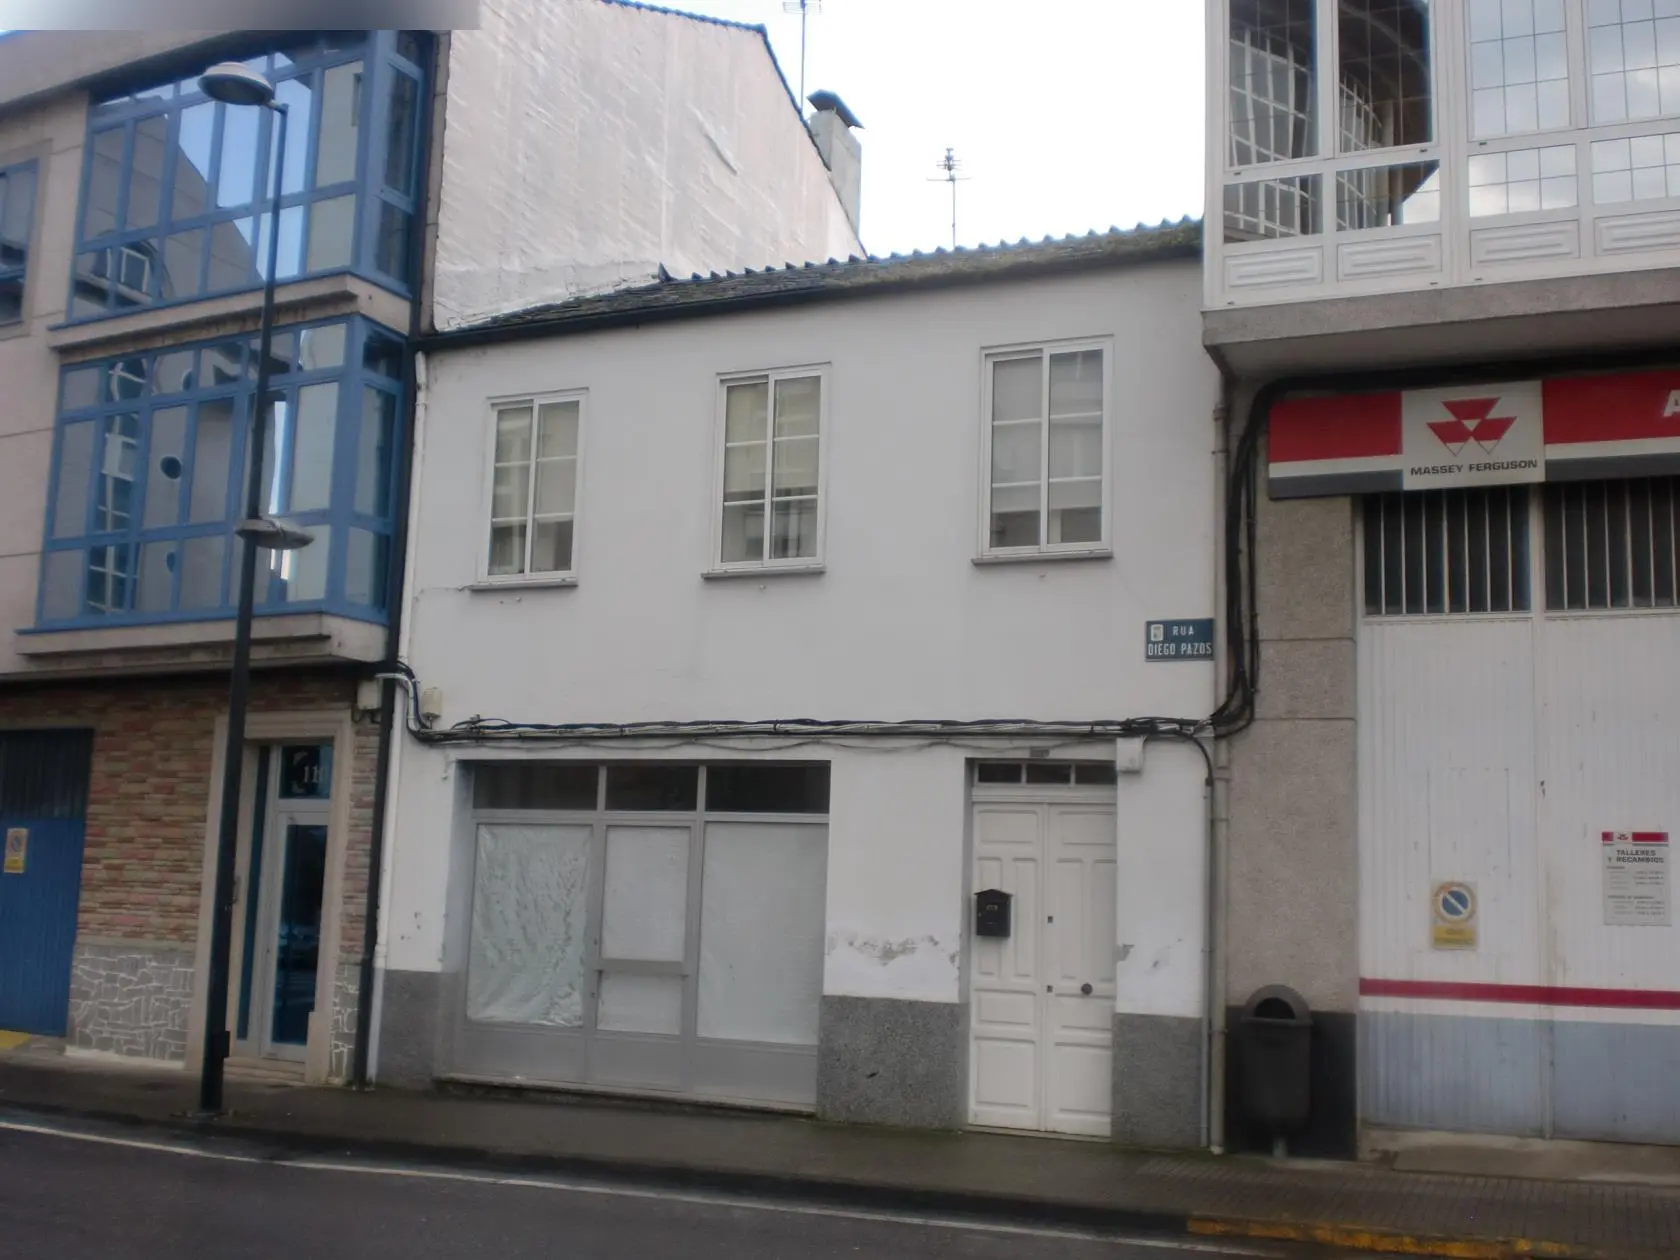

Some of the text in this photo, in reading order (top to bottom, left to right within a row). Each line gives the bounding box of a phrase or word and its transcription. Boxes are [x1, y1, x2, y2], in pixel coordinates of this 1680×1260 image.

[1410, 459, 1538, 476] MASSEY FERGUSON
[1172, 625, 1195, 636] RUA
[1148, 642, 1212, 656] DIEGO PAZOS
[1616, 856, 1665, 864] RECAMBIOS
